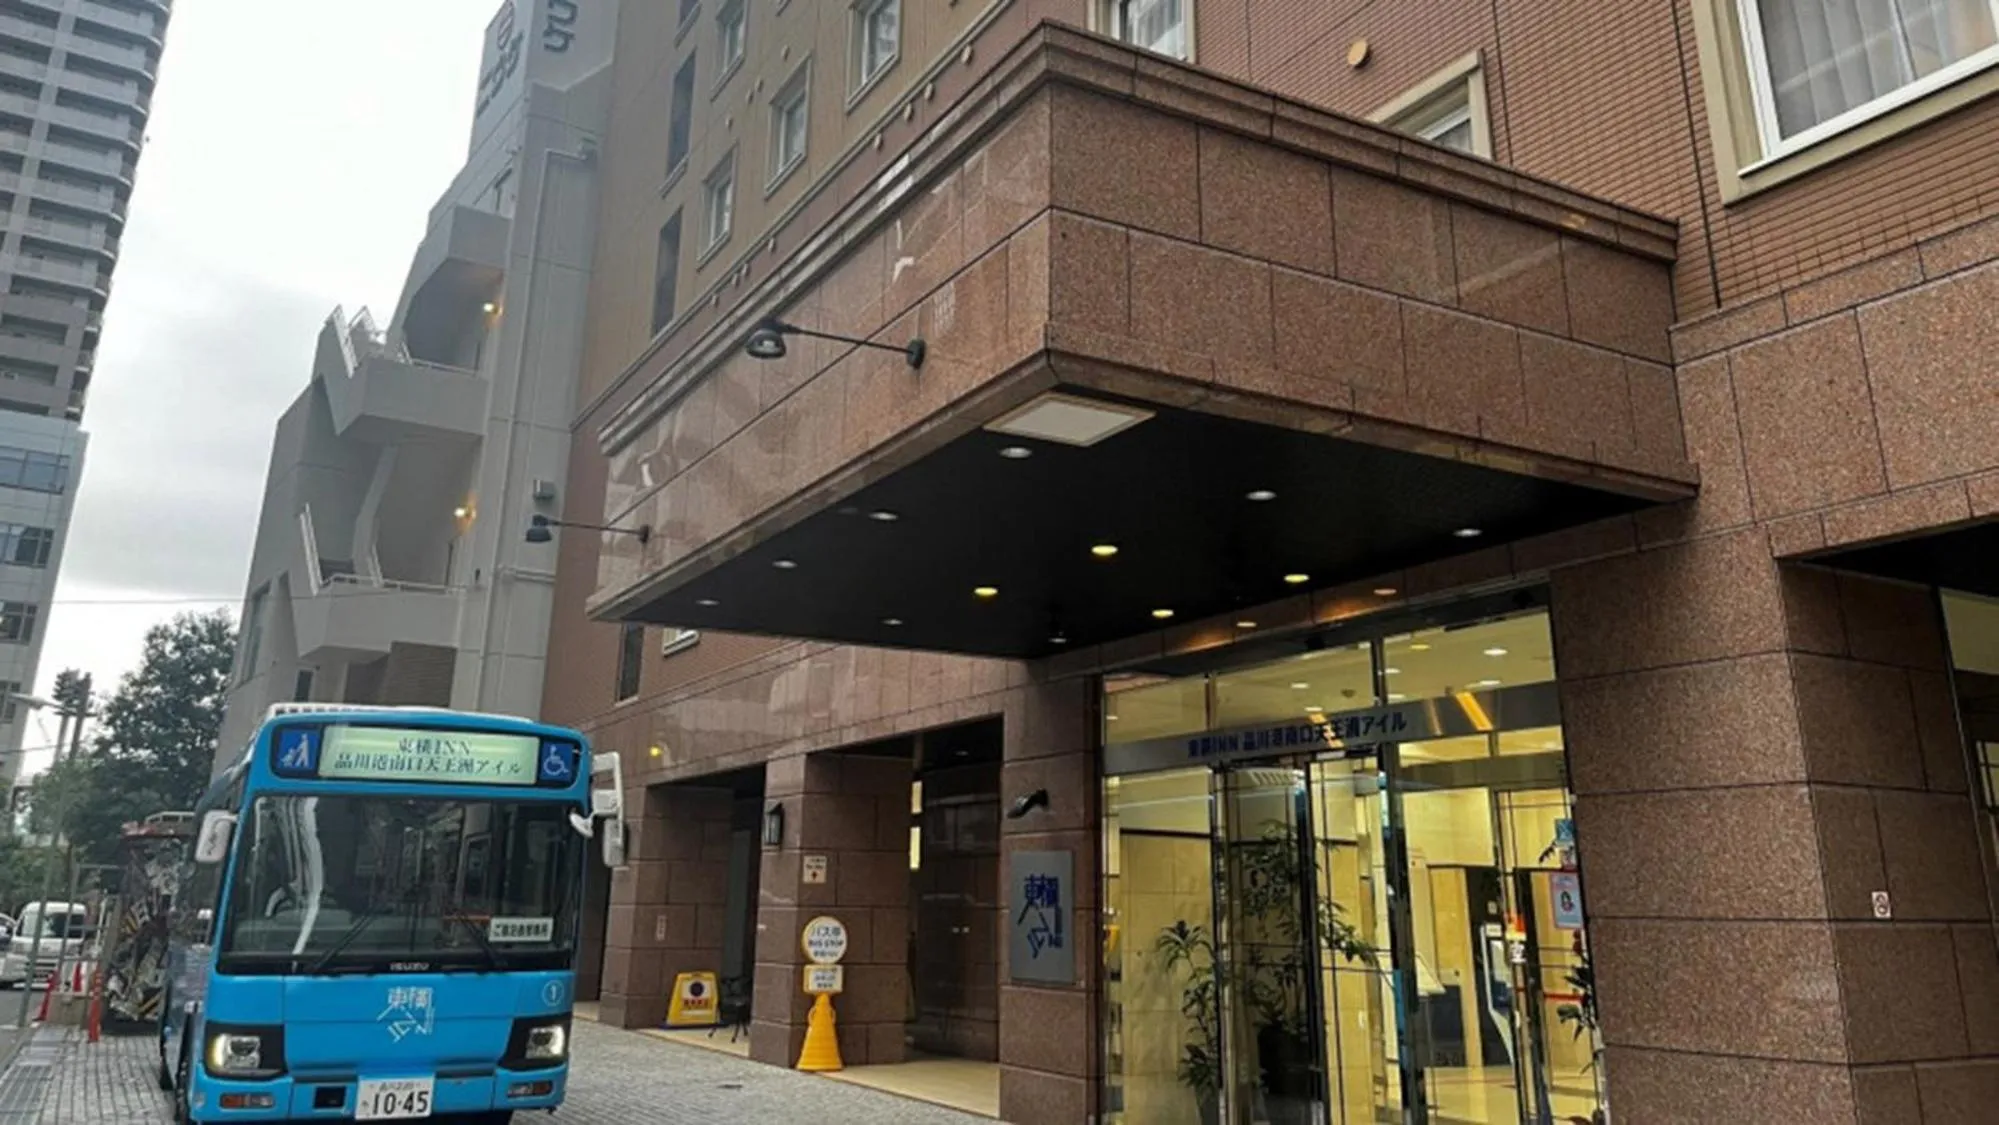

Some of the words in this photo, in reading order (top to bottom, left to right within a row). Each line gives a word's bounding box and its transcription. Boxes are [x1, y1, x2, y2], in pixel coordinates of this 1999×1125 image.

[400, 737, 472, 756] 東横INN
[334, 752, 522, 775] 品川港南口天王洲アイル
[390, 962, 429, 971] ISUZU
